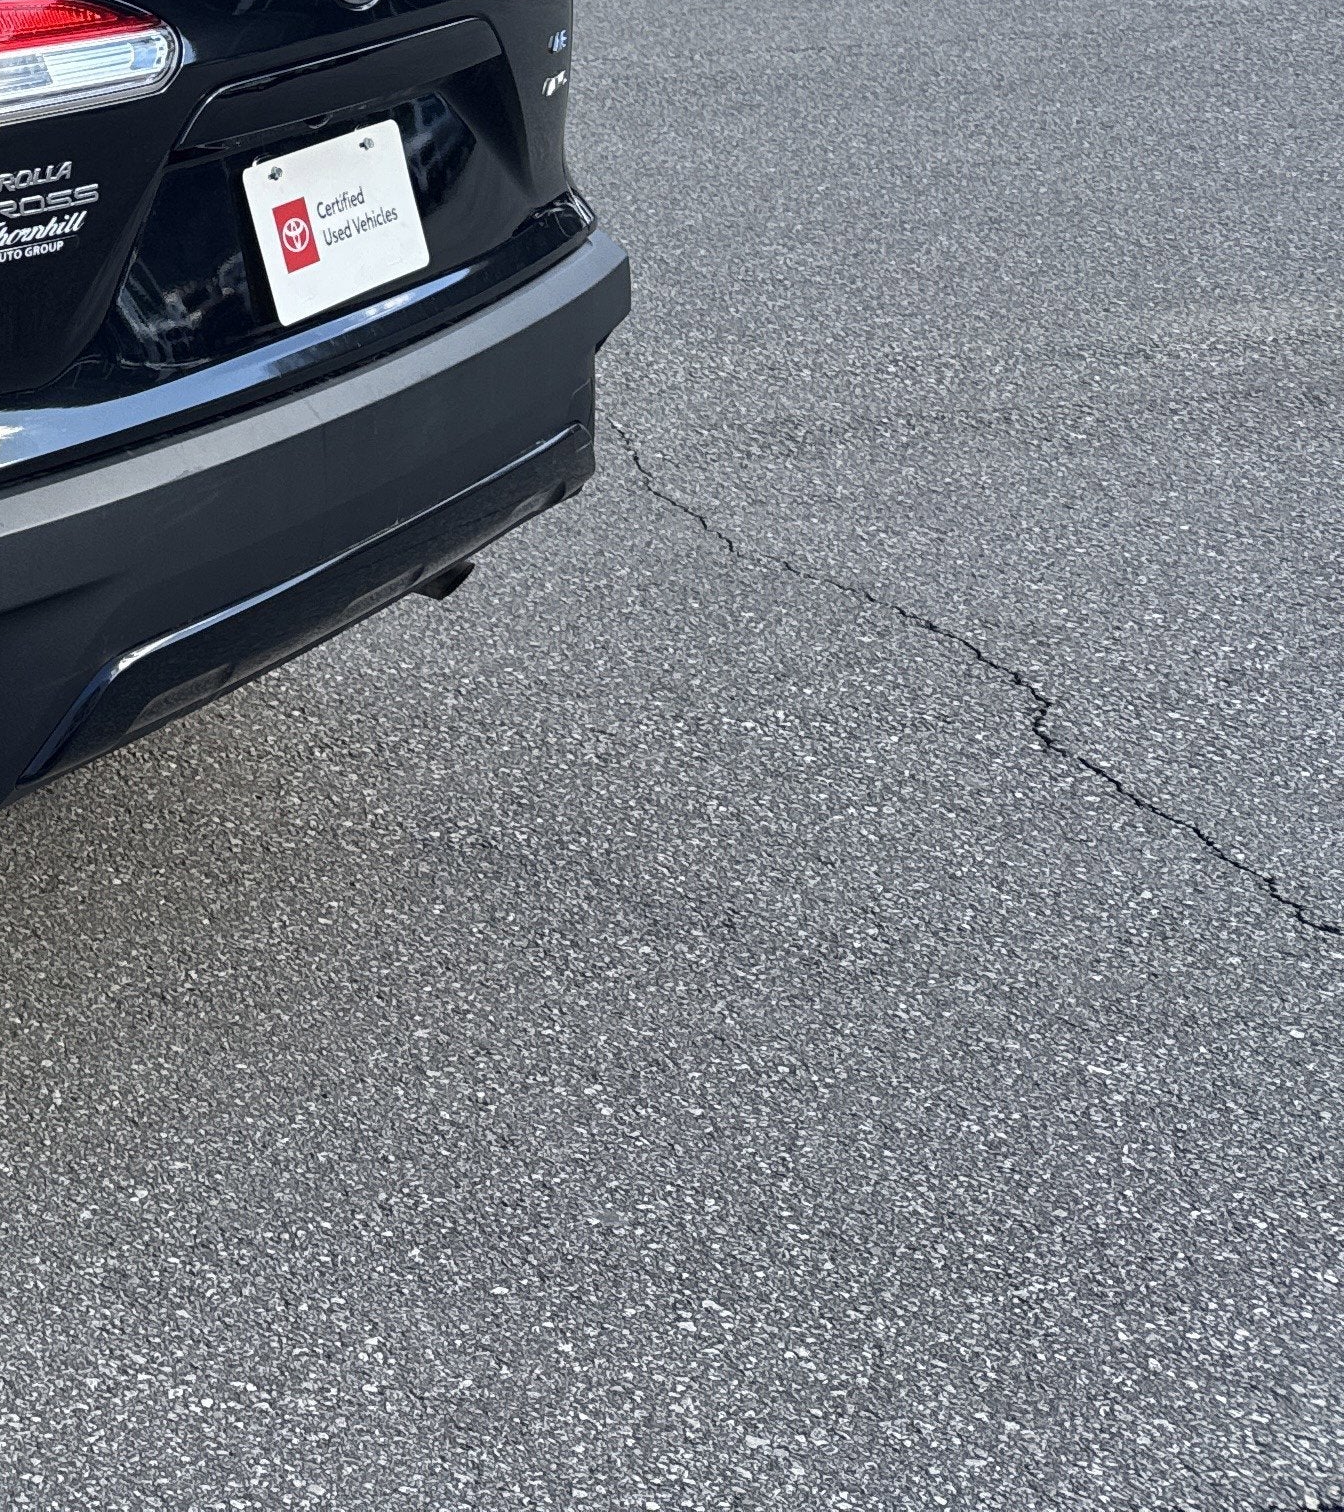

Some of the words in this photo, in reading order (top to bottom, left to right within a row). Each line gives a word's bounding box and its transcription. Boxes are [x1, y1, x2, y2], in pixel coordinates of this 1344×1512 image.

[316, 185, 366, 219] Certified
[322, 222, 353, 246] Used
[352, 205, 399, 236] Vehicles
[24, 240, 65, 258] GROUP
